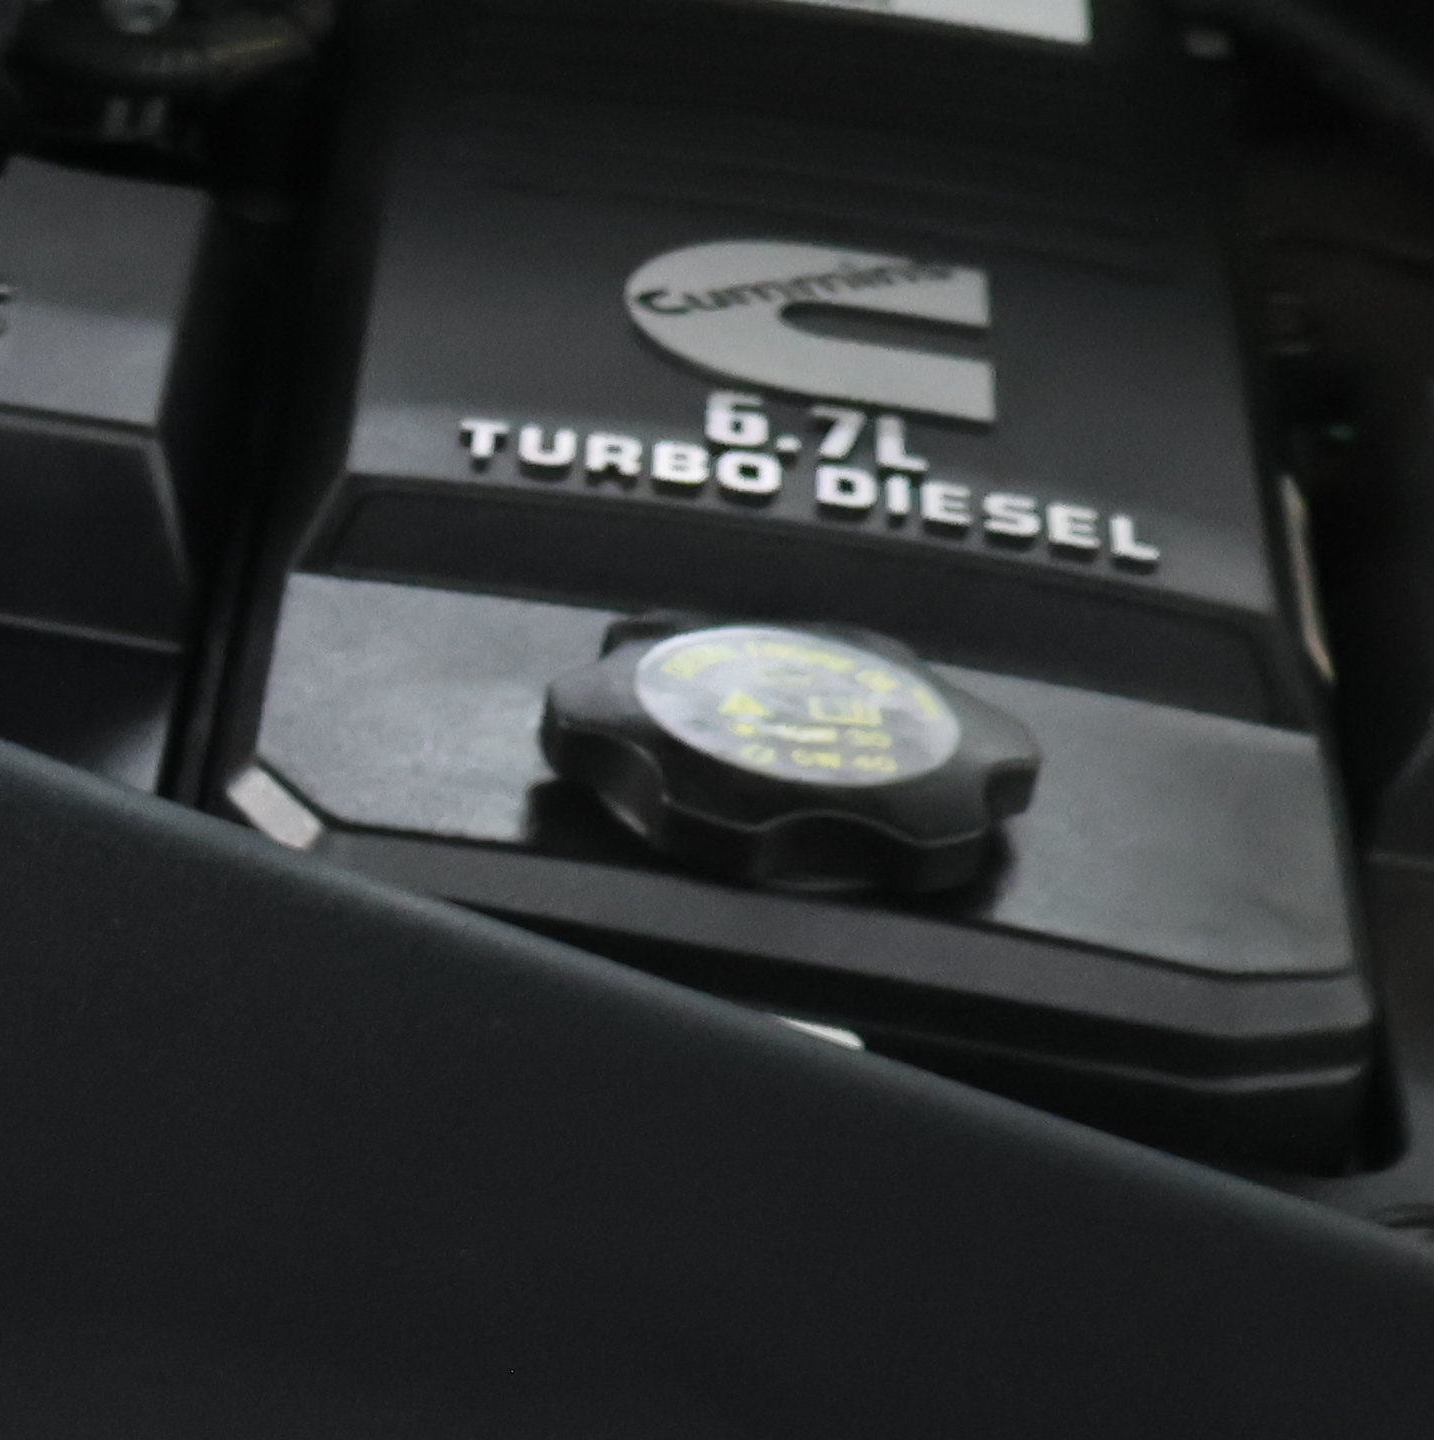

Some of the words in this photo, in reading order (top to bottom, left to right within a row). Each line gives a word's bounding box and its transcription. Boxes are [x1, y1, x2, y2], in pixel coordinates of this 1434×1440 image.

[704, 391, 929, 473] 6.7L
[460, 417, 782, 496] TURBO
[812, 465, 1160, 560] DIESEL
